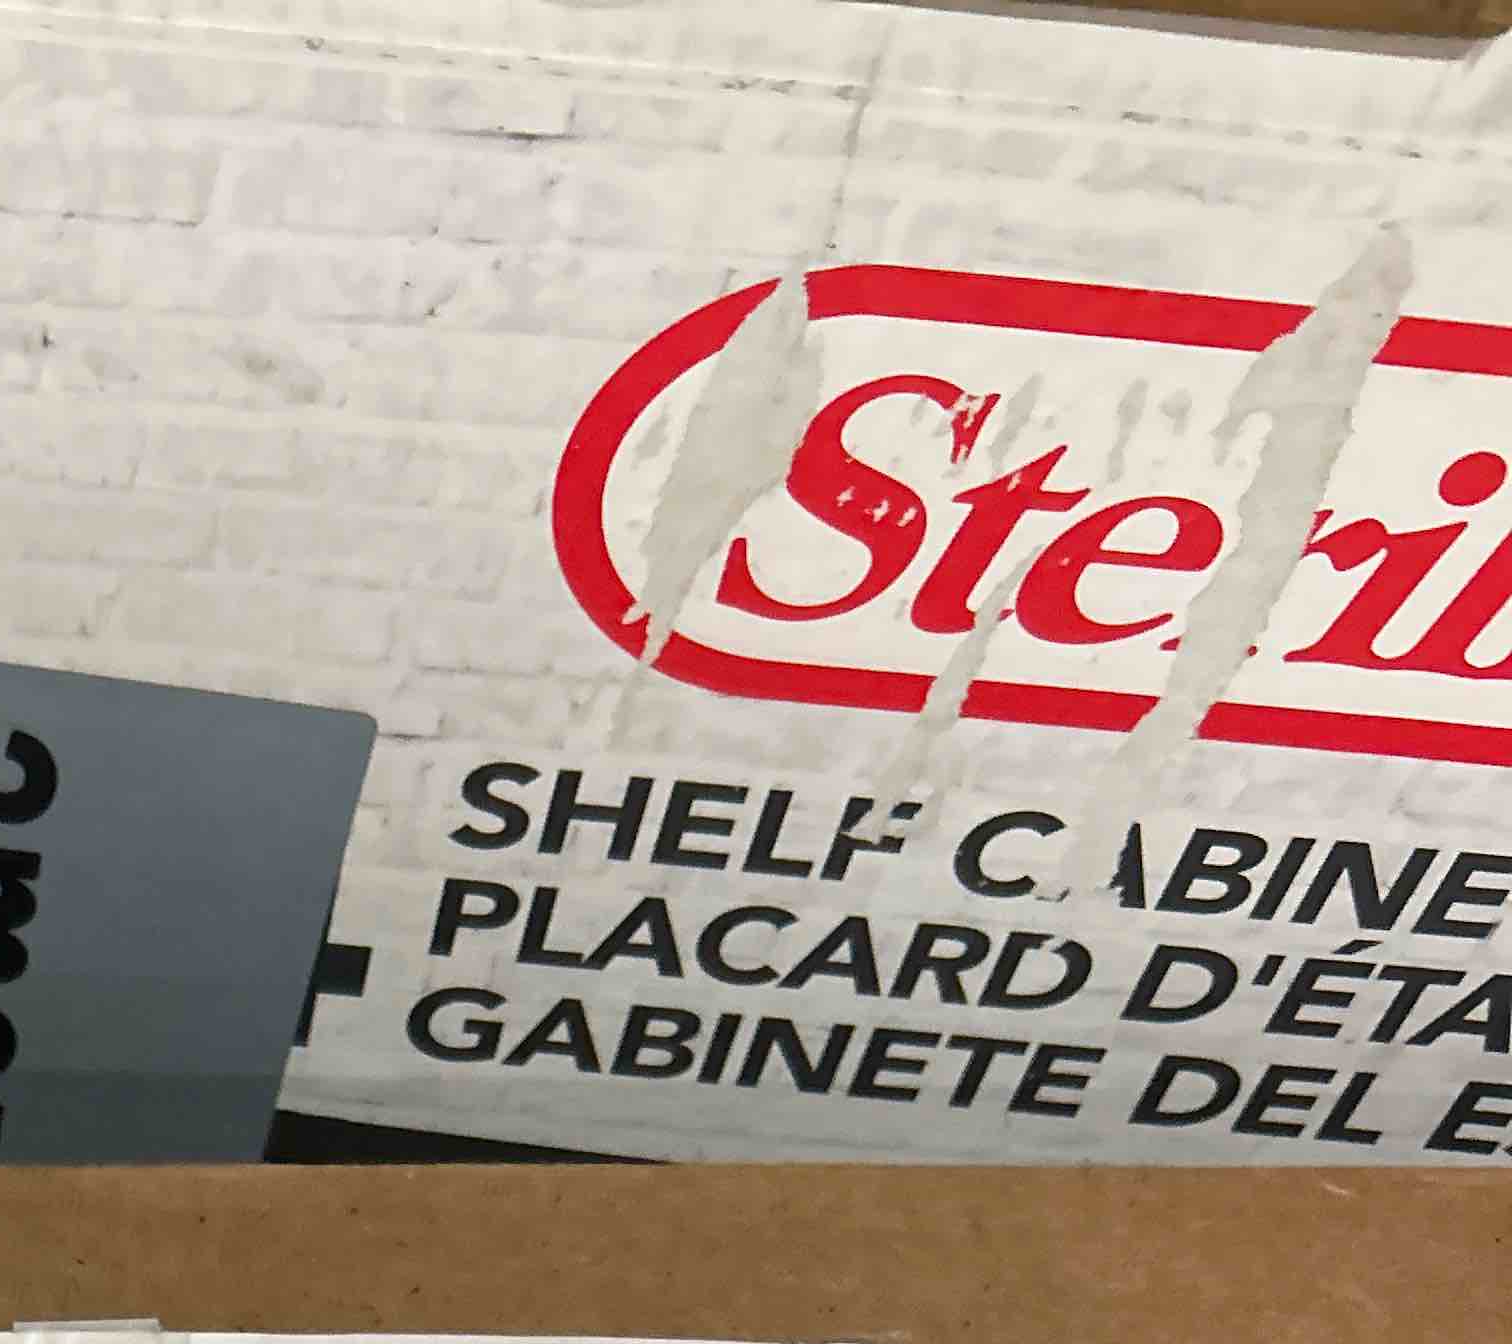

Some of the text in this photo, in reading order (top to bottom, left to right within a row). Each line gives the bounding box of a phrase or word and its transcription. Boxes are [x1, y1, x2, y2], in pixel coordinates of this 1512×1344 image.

[449, 761, 923, 881] SHELF
[428, 878, 1092, 1011] PLACARD
[1120, 939, 1512, 1054] D'ÉTA
[406, 989, 1104, 1119] GABINETE
[1129, 1054, 1382, 1145] DEL
[1424, 1081, 1512, 1156] E
